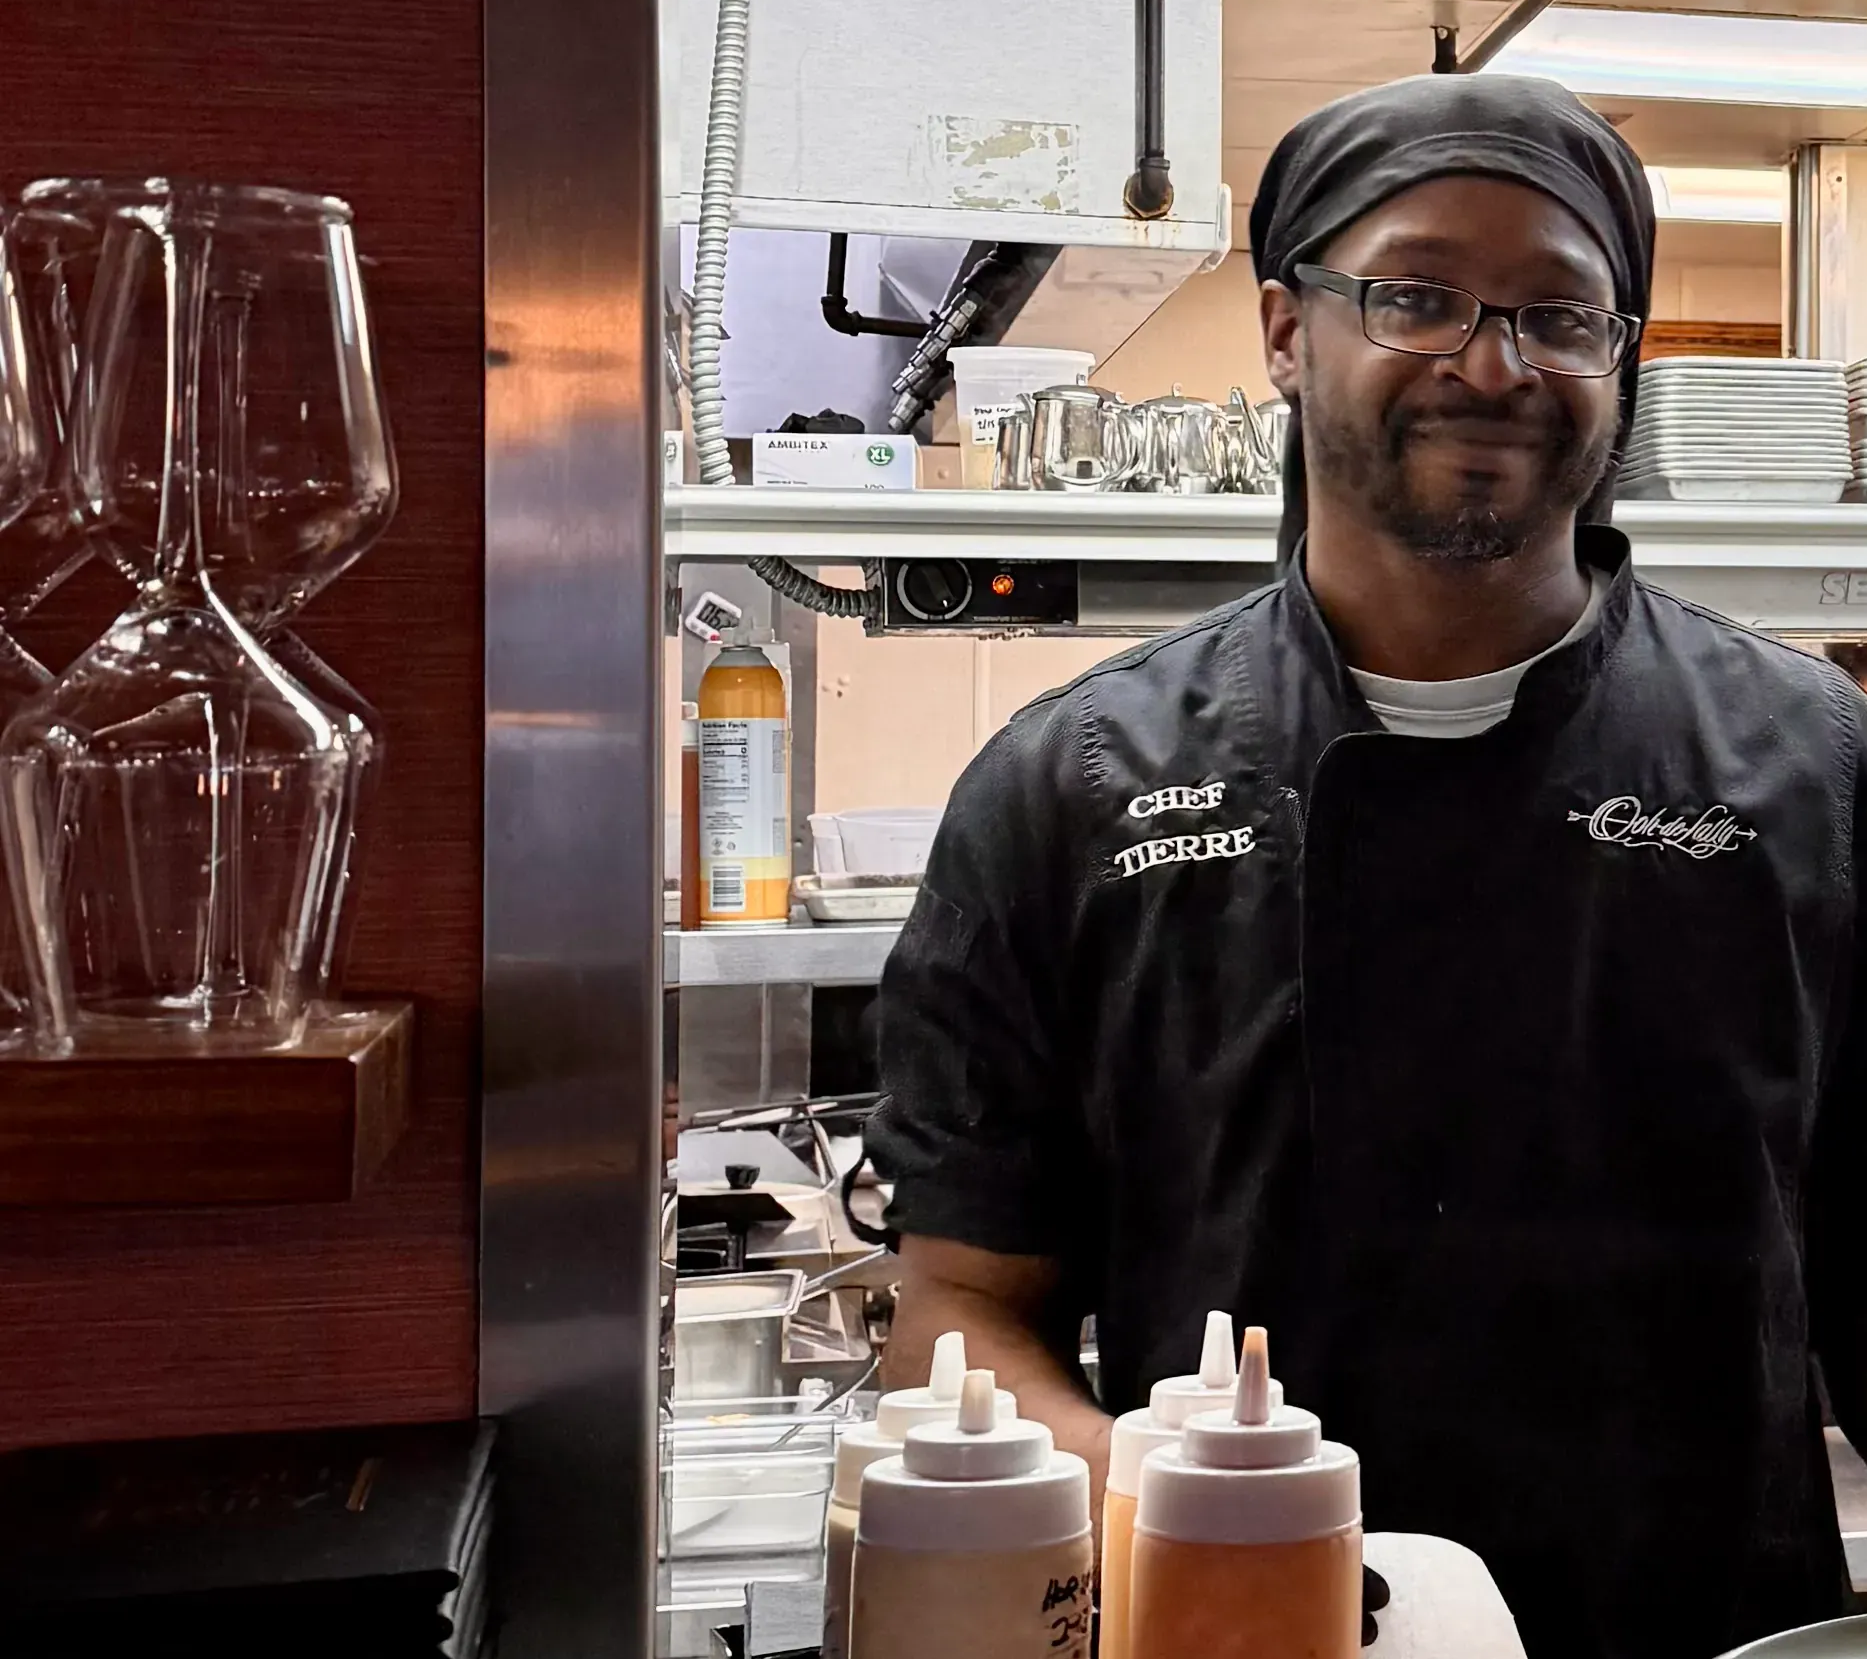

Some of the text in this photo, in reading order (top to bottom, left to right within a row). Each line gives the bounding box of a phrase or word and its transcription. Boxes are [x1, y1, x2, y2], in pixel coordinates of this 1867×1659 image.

[870, 446, 891, 461] XL
[1128, 782, 1226, 818] CHEF
[1114, 826, 1256, 877] TIERRE
